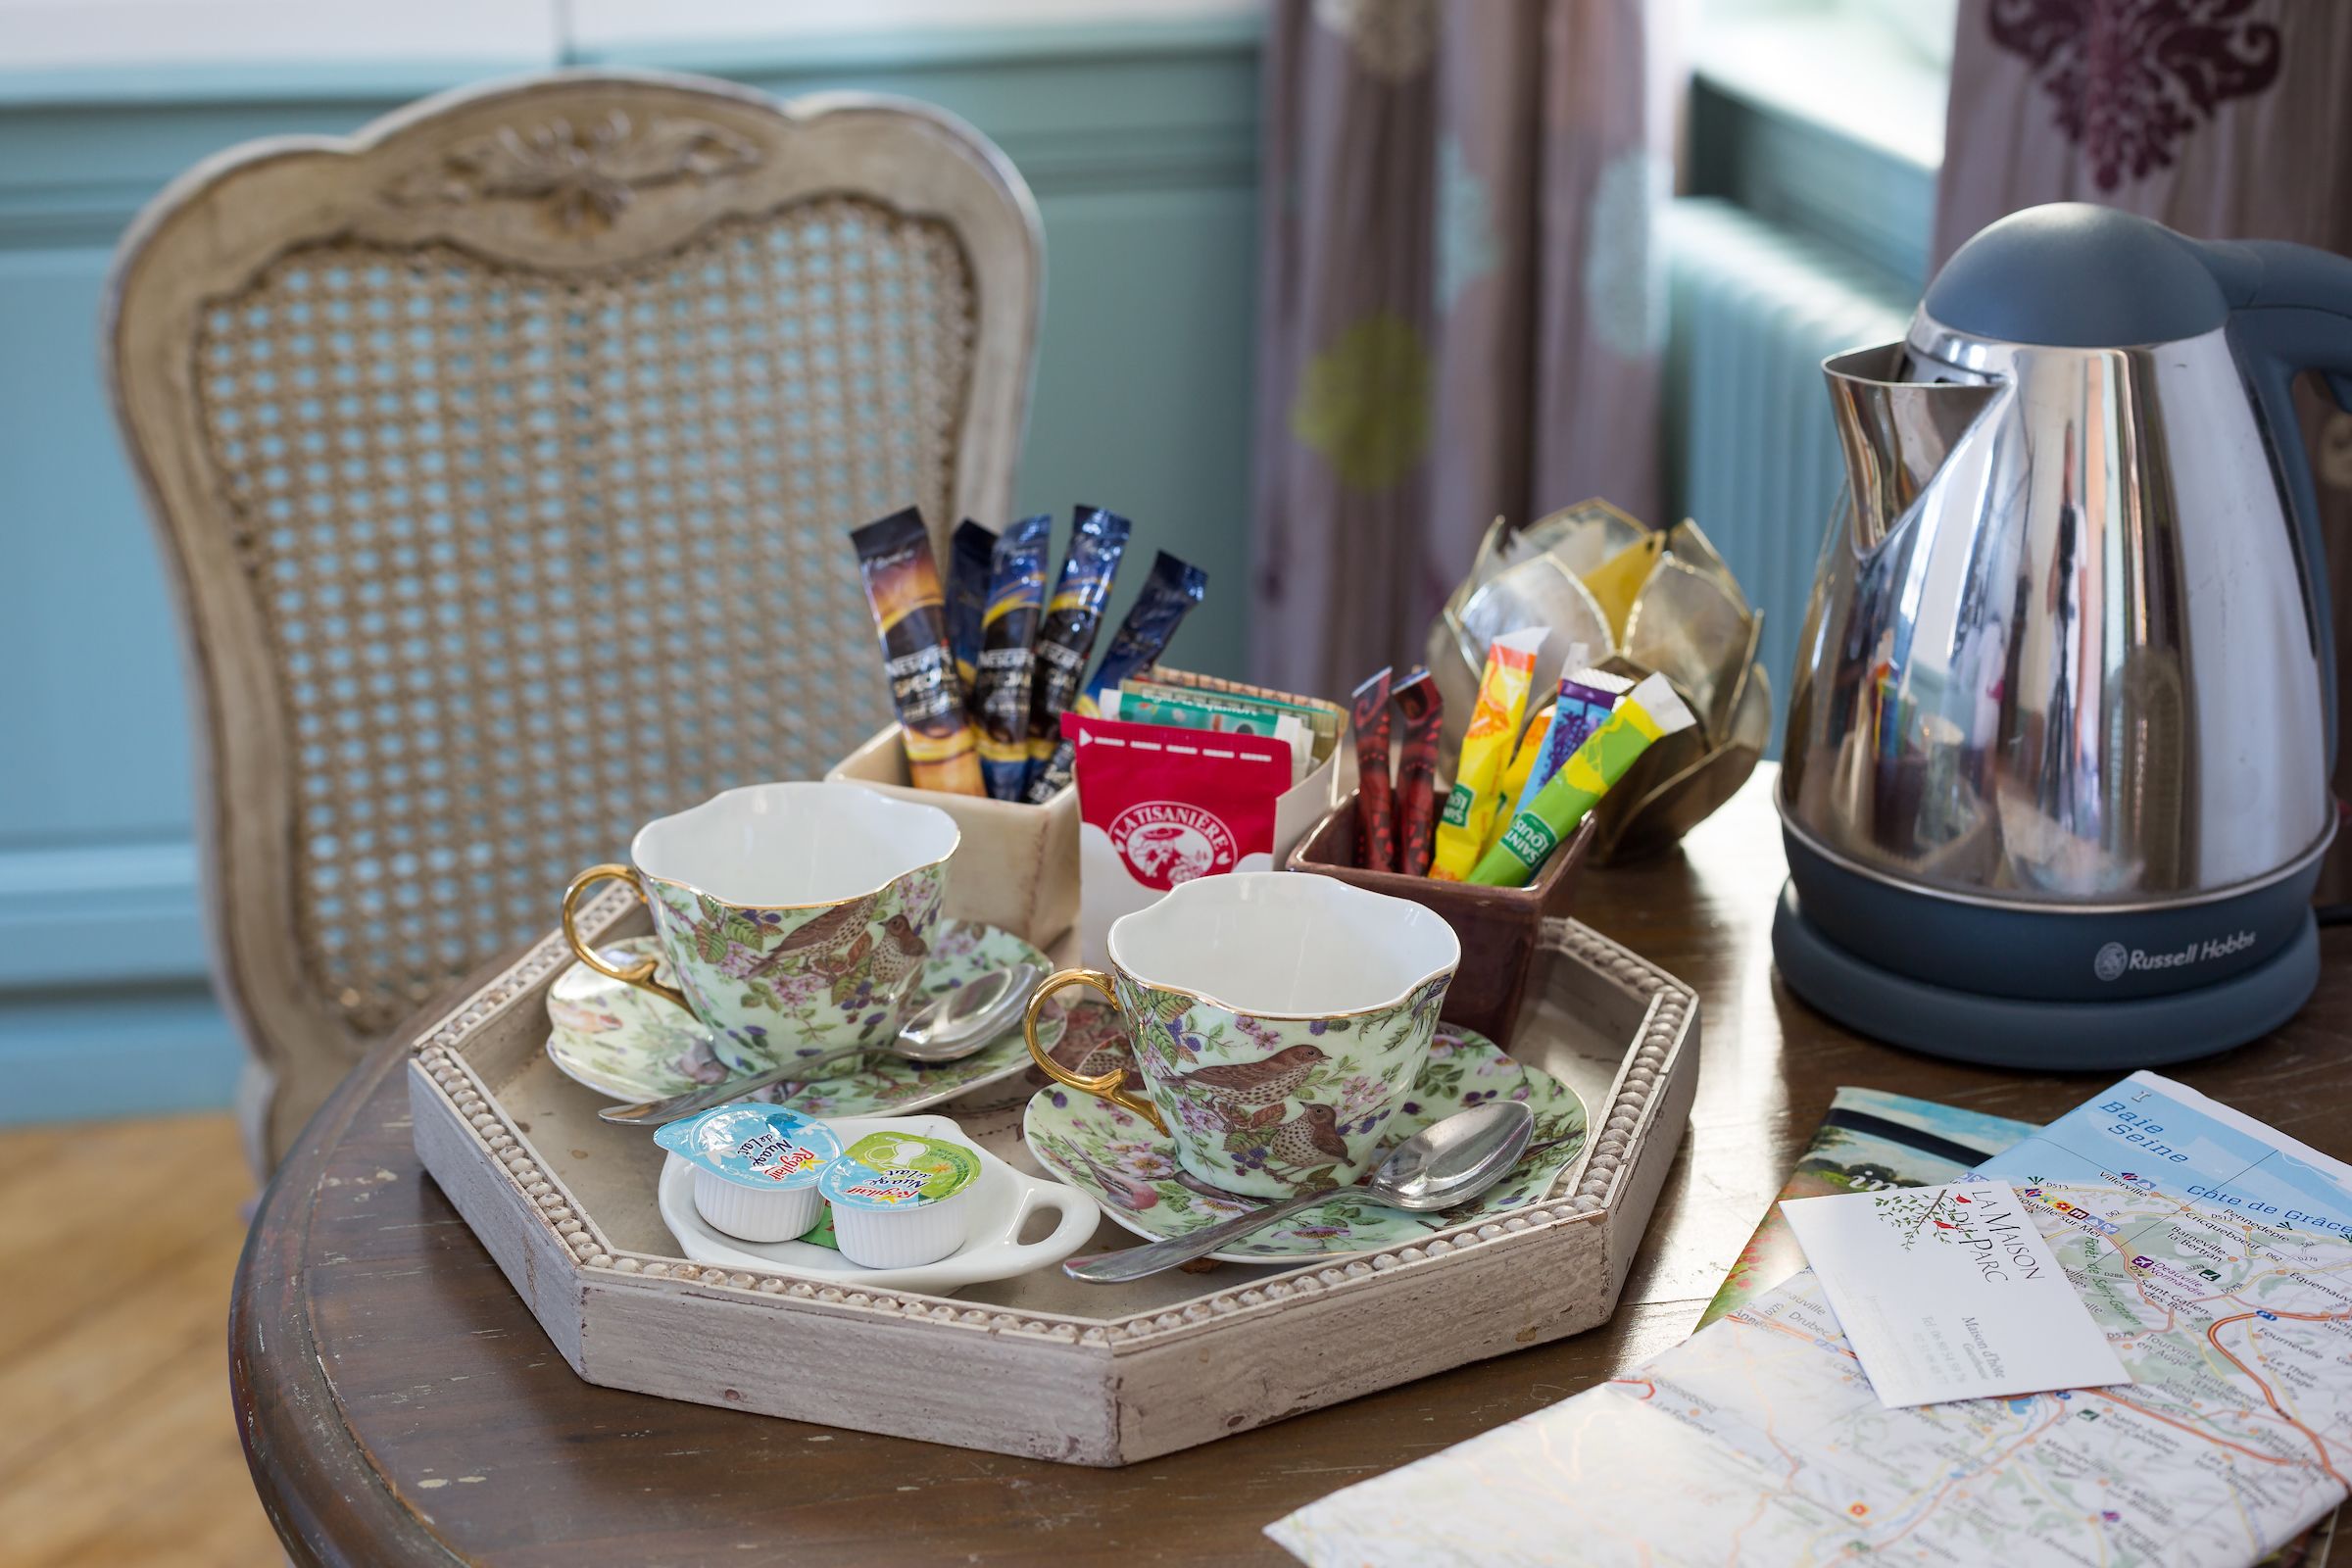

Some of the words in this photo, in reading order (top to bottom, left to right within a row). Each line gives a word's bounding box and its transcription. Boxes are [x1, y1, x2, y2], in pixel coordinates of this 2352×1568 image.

[1504, 830, 1541, 864] SAINT
[1515, 819, 1548, 854] LOUIS
[2129, 944, 2198, 970] Russell
[2098, 1101, 2164, 1134] Baie
[753, 1140, 793, 1167] Nuage
[2108, 1123, 2188, 1163] Seine
[1972, 1191, 1998, 1209] LA
[2099, 1170, 2148, 1199] Villerville
[2186, 1185, 2242, 1206] Côte
[2247, 1200, 2278, 1214] de
[2284, 1209, 2352, 1234] Grâce
[1958, 1239, 2010, 1283] PARC
[2266, 1251, 2282, 1262] D62
[2148, 1267, 2205, 1298] Normandie
[2154, 1262, 2203, 1288] Deauville
[1788, 1311, 1830, 1337] Drubec
[2258, 1326, 2324, 1360] Fourneville
